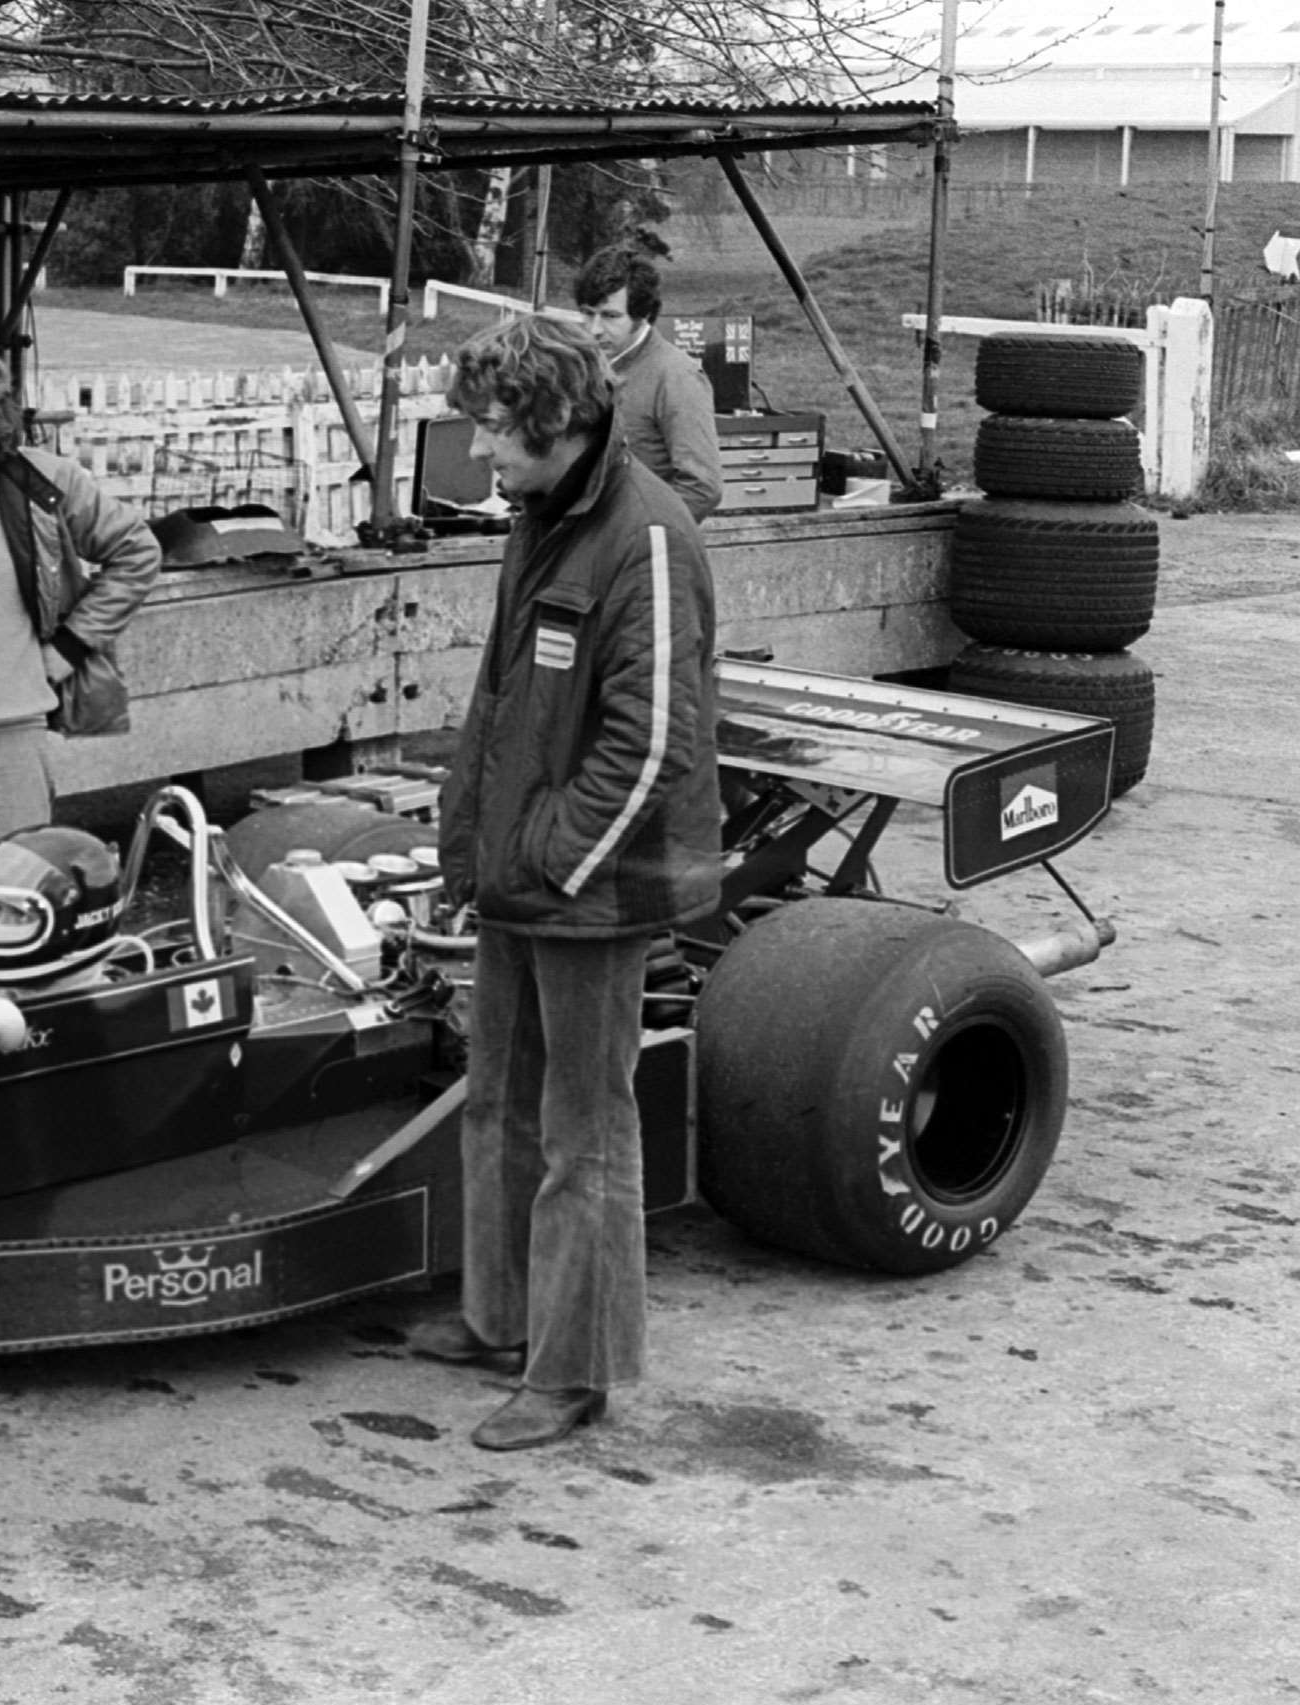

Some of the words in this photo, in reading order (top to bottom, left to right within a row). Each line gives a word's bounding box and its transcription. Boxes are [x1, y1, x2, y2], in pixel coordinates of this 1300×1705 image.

[784, 701, 982, 742] GOODYEAR
[1003, 795, 1056, 829] Marlboro
[878, 1005, 999, 1252] GOODYEAR
[104, 1250, 263, 1301] Personal
